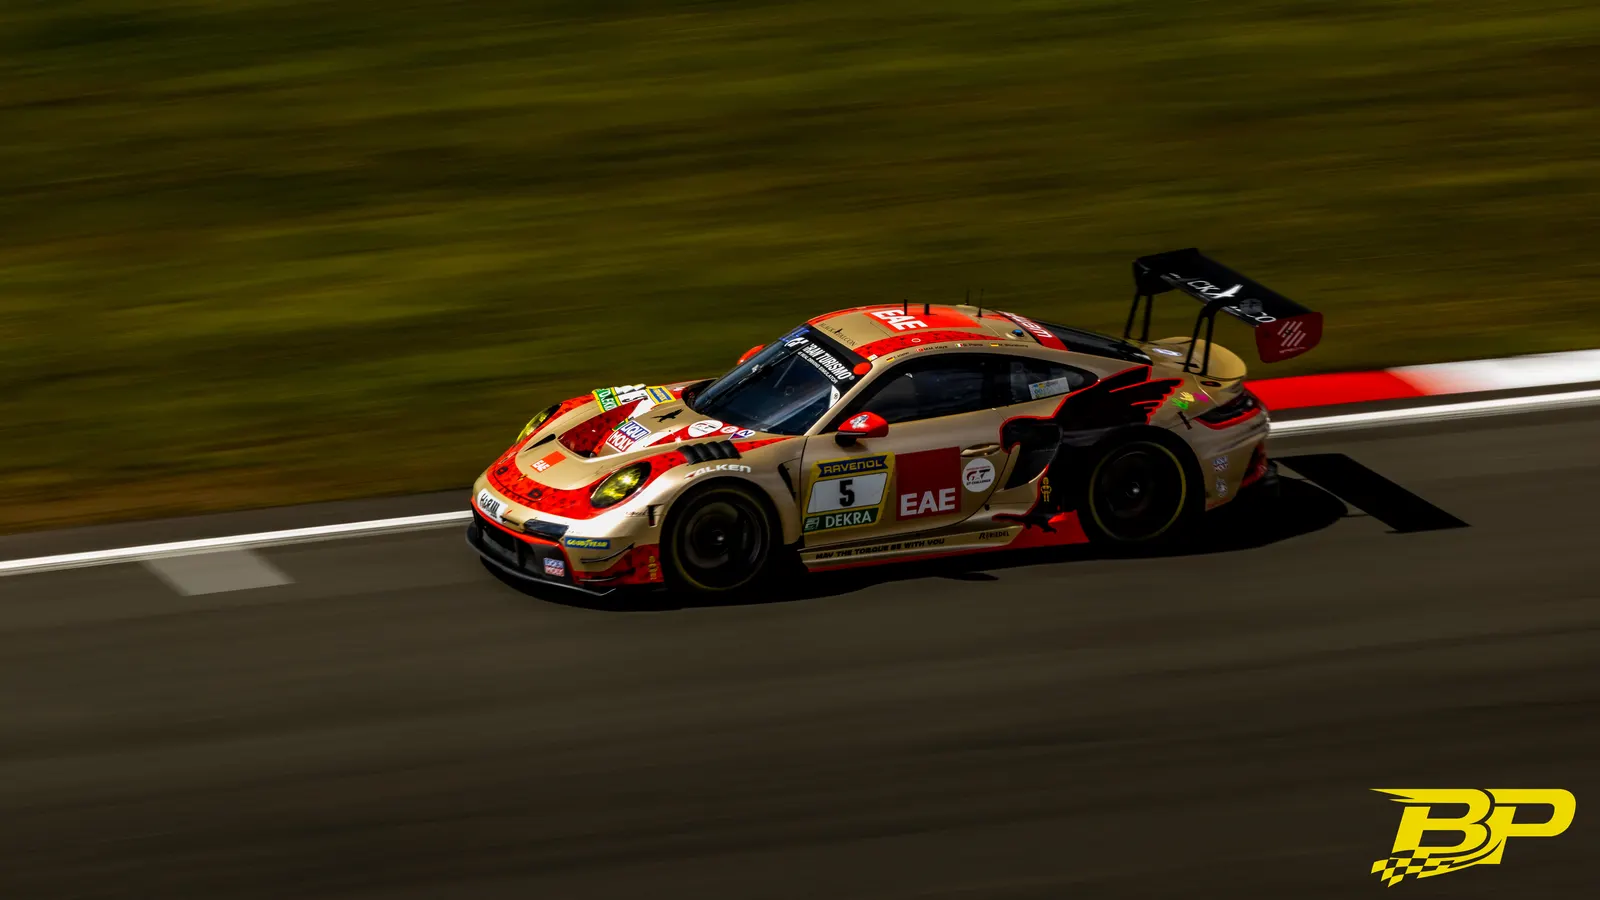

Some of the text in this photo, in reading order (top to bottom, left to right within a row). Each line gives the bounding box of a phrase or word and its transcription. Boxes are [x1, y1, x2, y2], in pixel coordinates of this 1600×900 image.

[871, 309, 929, 331] EAE
[608, 431, 634, 452] MOLY
[684, 464, 751, 479] FALKEN
[823, 460, 883, 475] RAVENOL
[839, 479, 855, 507] 5
[900, 488, 955, 517] EAE
[825, 511, 872, 528] DEKRA
[567, 539, 608, 547] GOODYEAR
[855, 545, 889, 554] TORQUE
[904, 540, 924, 549] WITH
[927, 538, 945, 546] YOU
